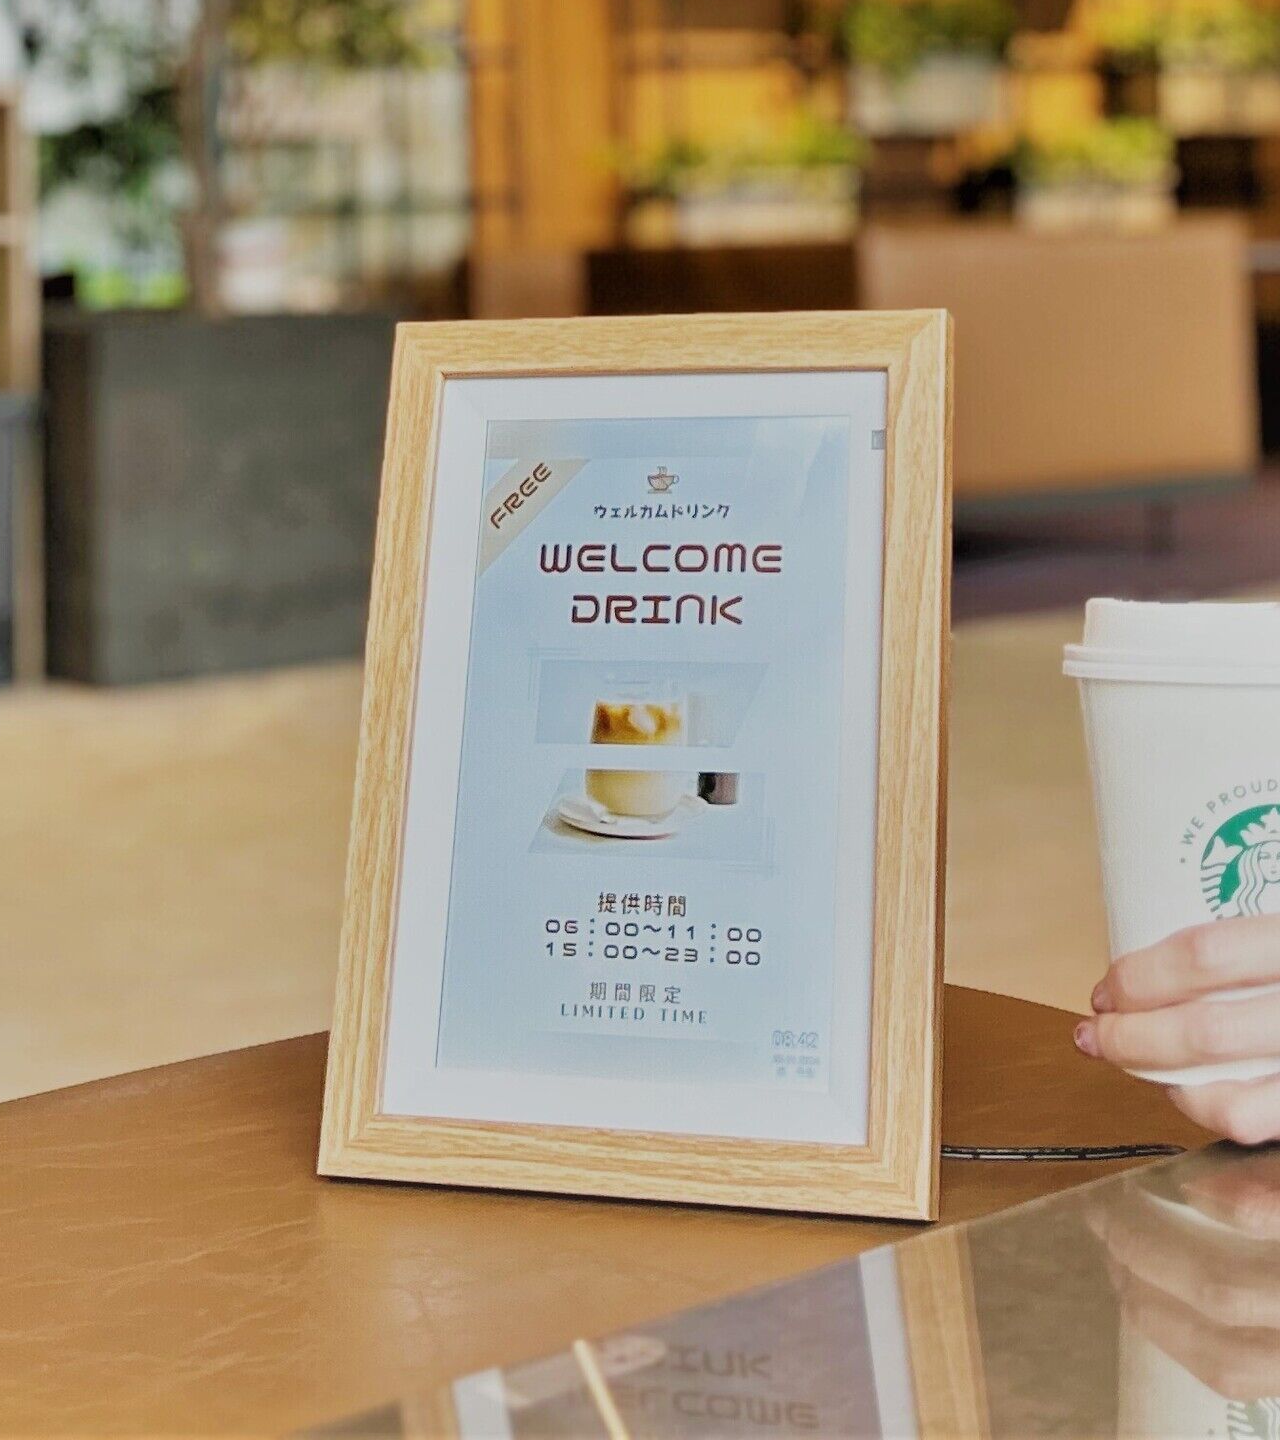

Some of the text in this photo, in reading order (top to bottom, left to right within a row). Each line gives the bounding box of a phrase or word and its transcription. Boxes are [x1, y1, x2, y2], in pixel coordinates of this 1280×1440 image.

[490, 462, 552, 529] FREE
[593, 504, 731, 519] ウェルカムドリンク
[540, 543, 783, 573] WELCOME
[571, 594, 743, 625] DRINK
[1181, 816, 1205, 846] WE
[598, 892, 687, 917] 提供時間
[589, 981, 682, 1005] 期間限定
[561, 1003, 708, 1025] LIMITED TIME
